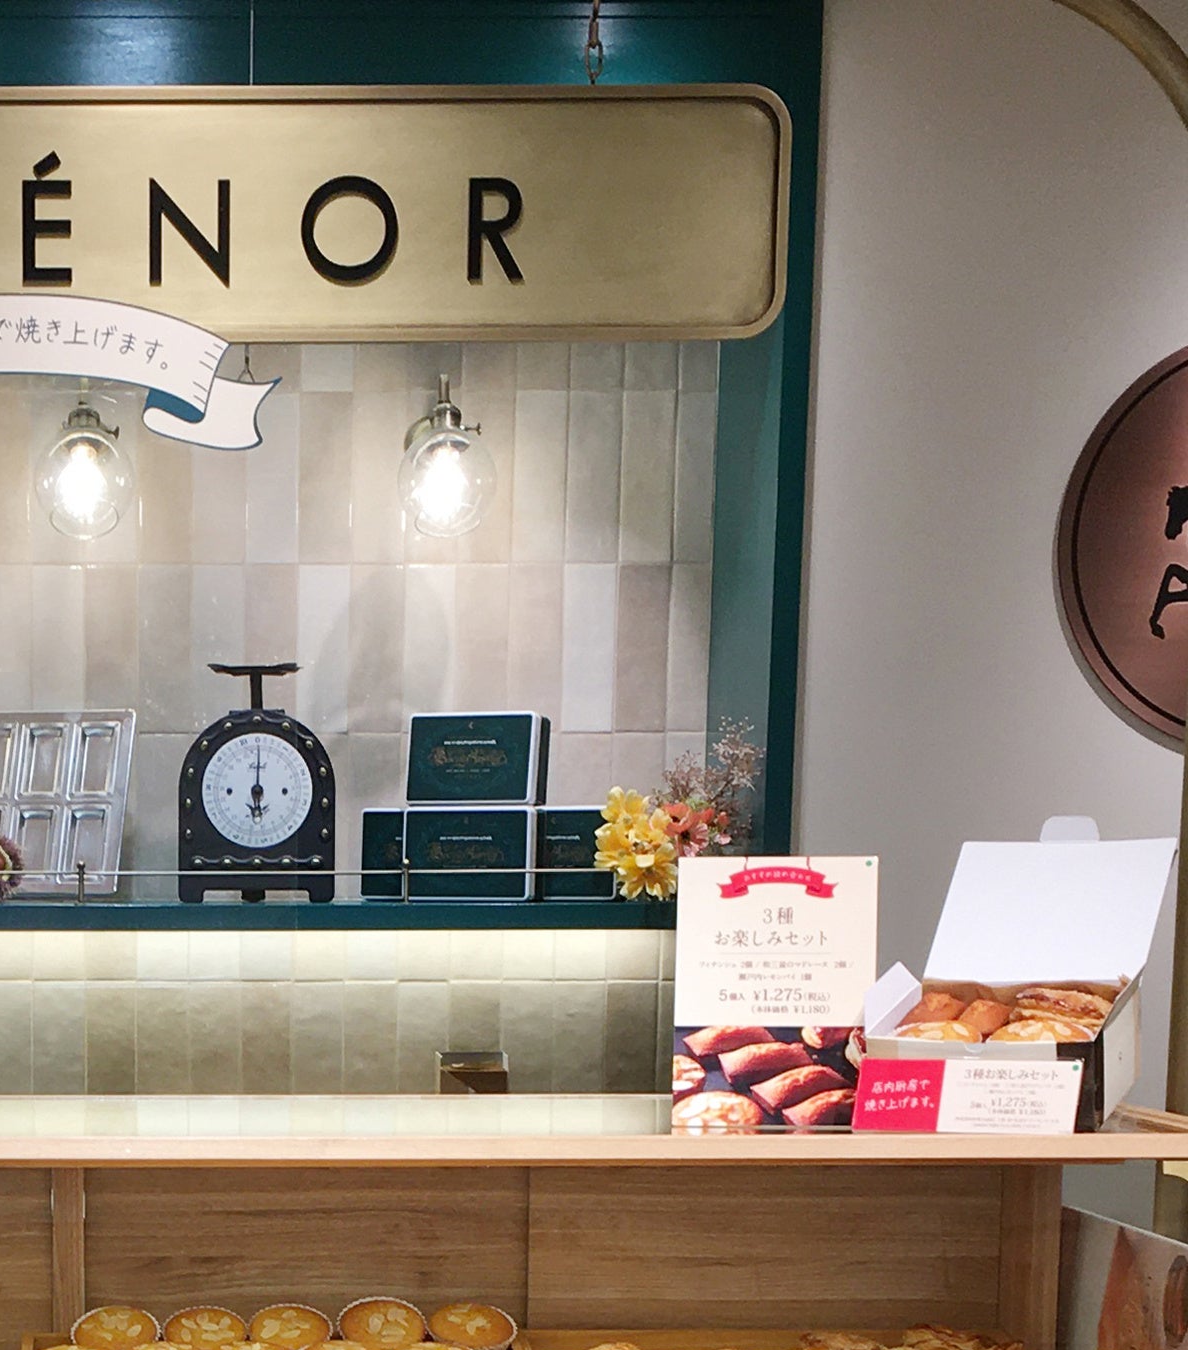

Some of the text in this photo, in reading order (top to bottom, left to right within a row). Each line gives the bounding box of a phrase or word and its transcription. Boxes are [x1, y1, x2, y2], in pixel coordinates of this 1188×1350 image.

[762, 906, 794, 924] 3種
[714, 929, 829, 947] お楽しみセット
